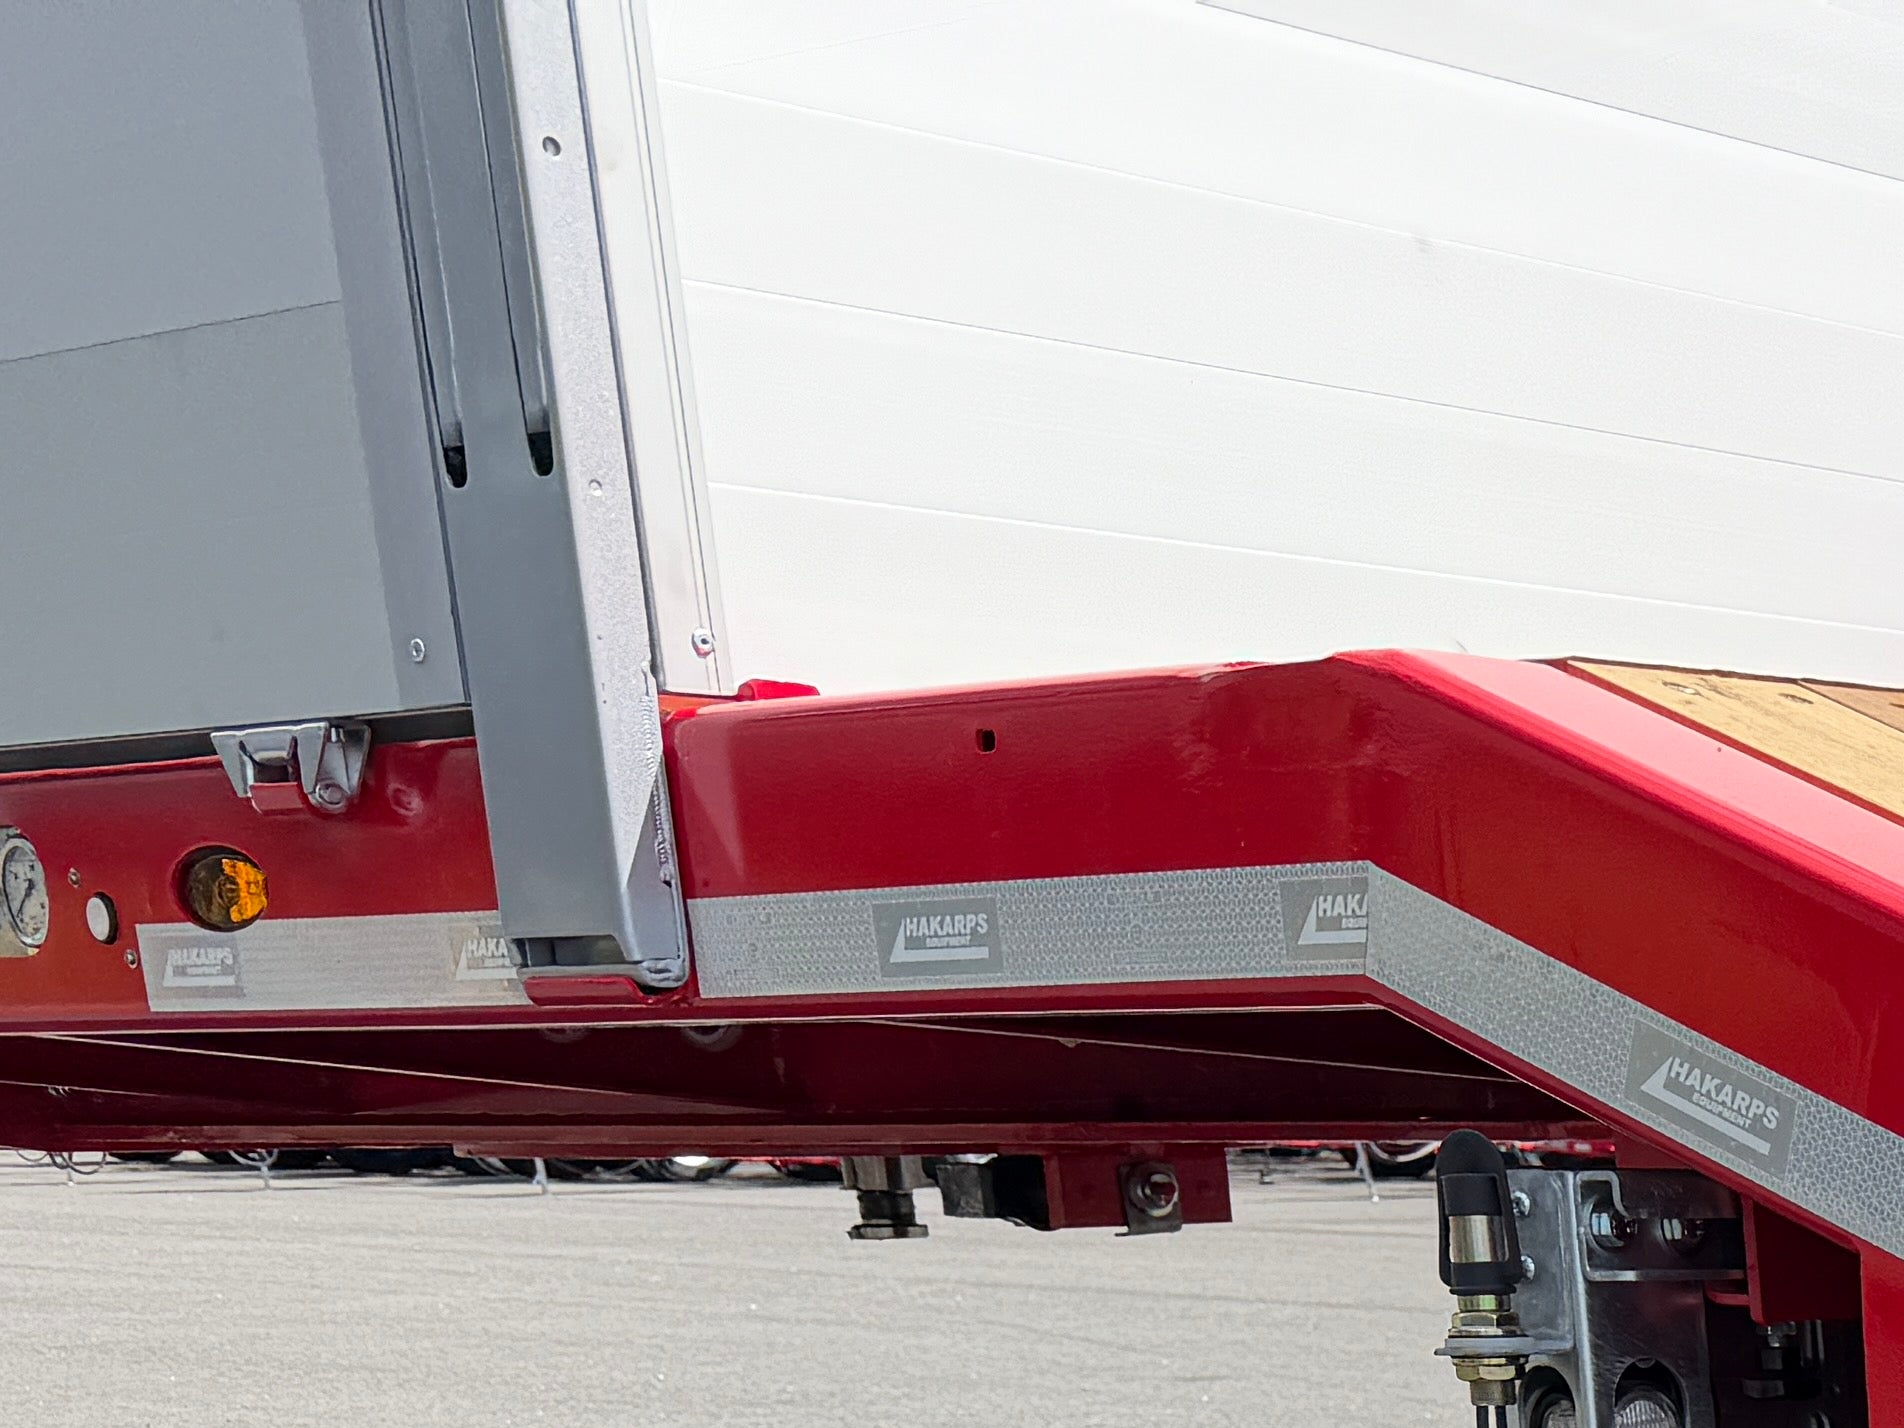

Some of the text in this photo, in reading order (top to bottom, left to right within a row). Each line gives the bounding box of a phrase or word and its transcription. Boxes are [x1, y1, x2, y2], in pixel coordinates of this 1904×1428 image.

[906, 913, 988, 937] HAKARPS
[467, 937, 508, 958] HAKA
[1670, 1057, 1779, 1129] HAKARPS
[1692, 1092, 1751, 1128] EQUIPMENT
